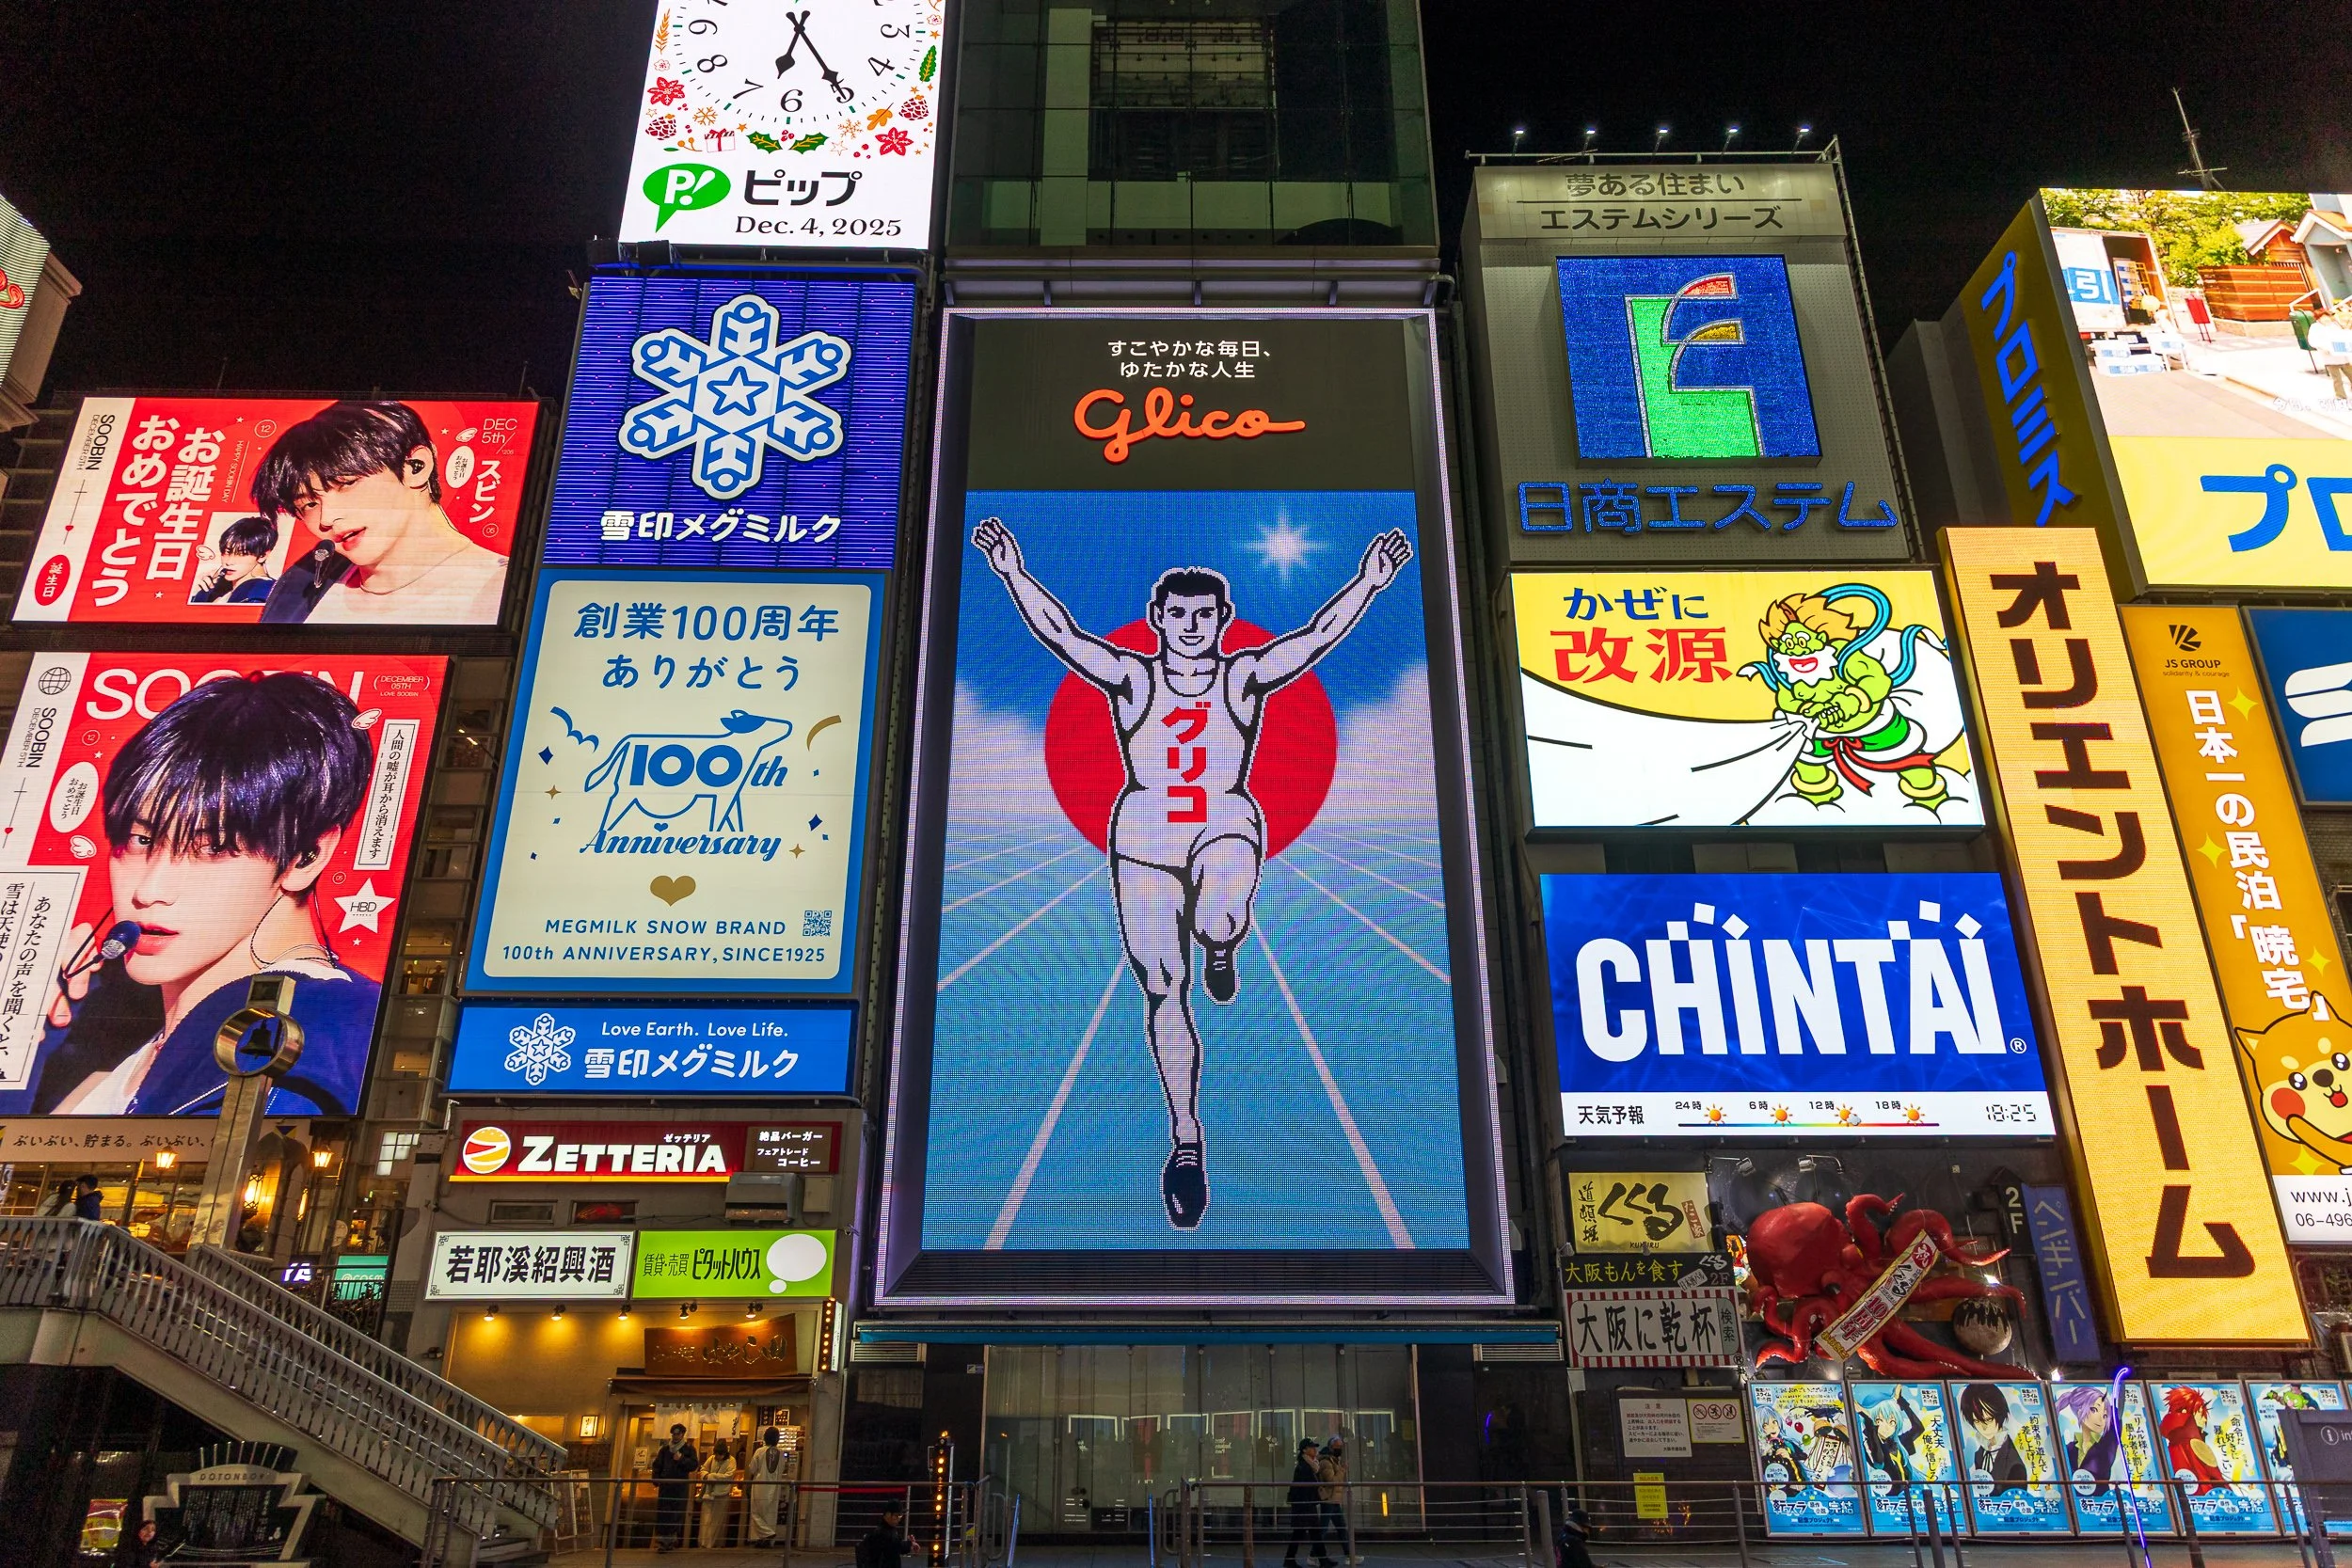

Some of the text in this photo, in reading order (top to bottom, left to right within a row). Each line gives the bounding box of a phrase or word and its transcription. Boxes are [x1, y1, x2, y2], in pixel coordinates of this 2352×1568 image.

[689, 19, 718, 36] 9
[880, 24, 911, 39] 3
[697, 55, 728, 72] 8
[867, 56, 895, 77] 4
[733, 78, 764, 100] 7
[780, 89, 803, 113] 6
[743, 169, 864, 207] ピップ
[1565, 172, 1745, 197] 夢ある住まい
[735, 215, 902, 238] Dec. 4, 2025
[1540, 205, 1784, 231] エステムシリーズ
[1107, 340, 1272, 358] すこやかな毎日、
[1120, 361, 1255, 379] ゆたかな人生
[1980, 250, 2075, 528] プロミス
[261, 424, 272, 433] 12
[483, 418, 518, 431] DEC
[1074, 387, 1306, 463] Glico
[86, 414, 116, 470] SOOBIN
[481, 432, 506, 444] 5th
[146, 427, 222, 580] お誕生日
[469, 460, 502, 524] スビン
[91, 414, 181, 608] おめでとう
[1518, 479, 1899, 534] 日商エステム
[600, 508, 842, 543] 雪印メグミルク
[1563, 586, 1709, 621] かぜに
[573, 601, 840, 643] 創業100周年
[1549, 626, 1734, 684] 改源
[2165, 658, 2221, 669] JS GROUP
[602, 654, 802, 692] ありがとう
[25, 707, 57, 768] SOOBIN
[629, 743, 790, 789] 100th
[1161, 702, 1211, 823] グリコ
[369, 729, 405, 860] 人間の嘘が耳から消えます
[580, 829, 783, 863] Anniversary
[350, 901, 377, 912] HBD
[545, 918, 787, 936] MEGMILK SNOW BRAND
[1989, 562, 2256, 1279] オリエントホーム
[501, 944, 555, 962] 100th
[1576, 900, 2007, 1063] CHINTAI
[601, 1022, 789, 1037] Love Earth. Love Life.
[583, 1044, 801, 1080] 雪印メグミルク
[1577, 1104, 1645, 1126] 天気予報
[1675, 1101, 1702, 1111] 24時
[1748, 1101, 1769, 1111] 6時
[1808, 1101, 1835, 1111] 12時
[1874, 1101, 1901, 1111] 18時
[1985, 1103, 2038, 1122] 18:25
[663, 1133, 711, 1144] ゼッテリア
[758, 1131, 823, 1142] 絶品バーガー
[517, 1135, 727, 1174] ZETTERIA
[756, 1148, 809, 1156] フェアトレード
[777, 1157, 821, 1167] コーヒー
[1578, 1180, 1599, 1243] 道頓堀
[445, 1244, 617, 1284] 若耶溪紹興酒
[691, 1247, 761, 1280] ピタットハウス
[1565, 1259, 1684, 1284] 大阪もんを食す
[2034, 1200, 2086, 1345] ペンギンバー
[1709, 1272, 1731, 1286] 2F
[1577, 1301, 1717, 1354] 大阪に乾杯
[1720, 1309, 1736, 1342] 検索
